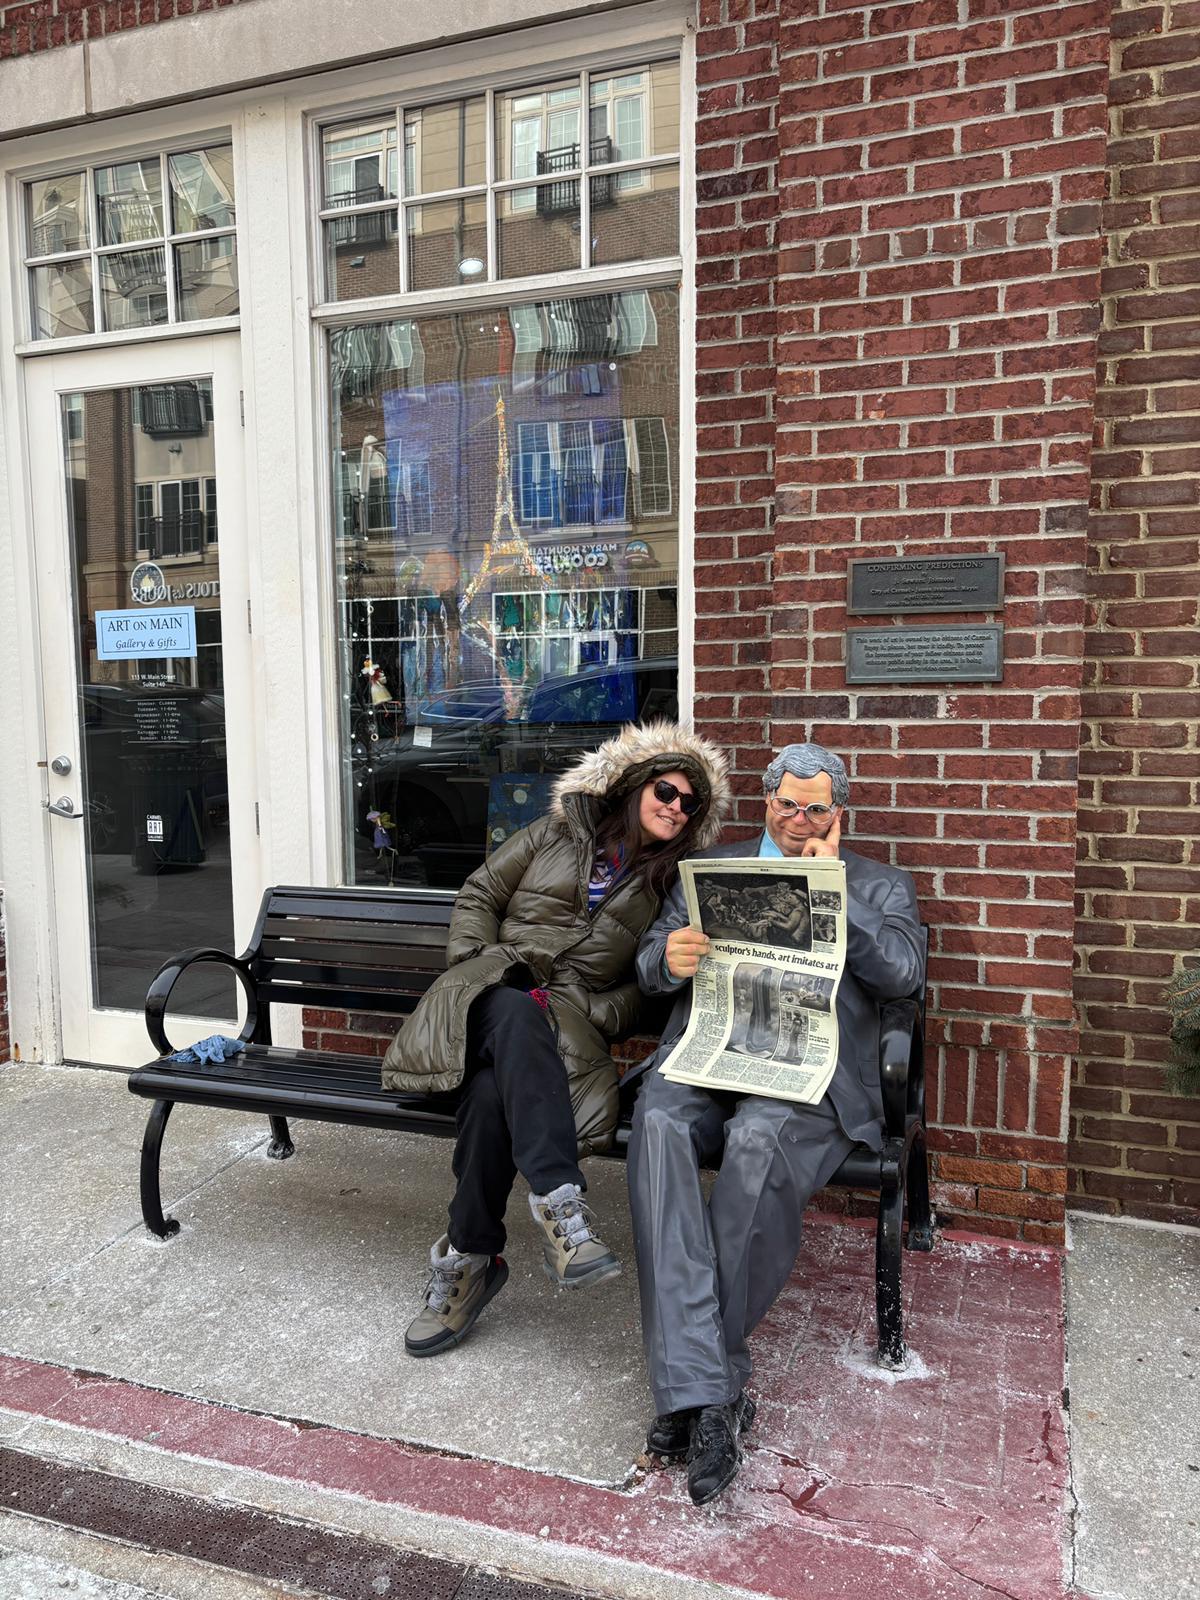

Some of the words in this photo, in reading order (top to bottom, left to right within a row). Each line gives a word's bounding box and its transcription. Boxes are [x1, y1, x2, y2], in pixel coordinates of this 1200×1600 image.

[868, 562, 922, 572] CONFIRMING
[926, 560, 983, 570] PREDICTIONS
[108, 619, 130, 632] ART
[133, 621, 147, 631] ON
[150, 617, 182, 630] MAIN
[115, 638, 146, 651] Gallery
[148, 639, 155, 648] &
[157, 637, 177, 650] Gifts
[149, 821, 161, 833] ART
[715, 944, 750, 956] sculptor's
[752, 948, 777, 961] hands,
[778, 954, 790, 963] art
[791, 954, 824, 969] imitates
[825, 962, 839, 971] art
